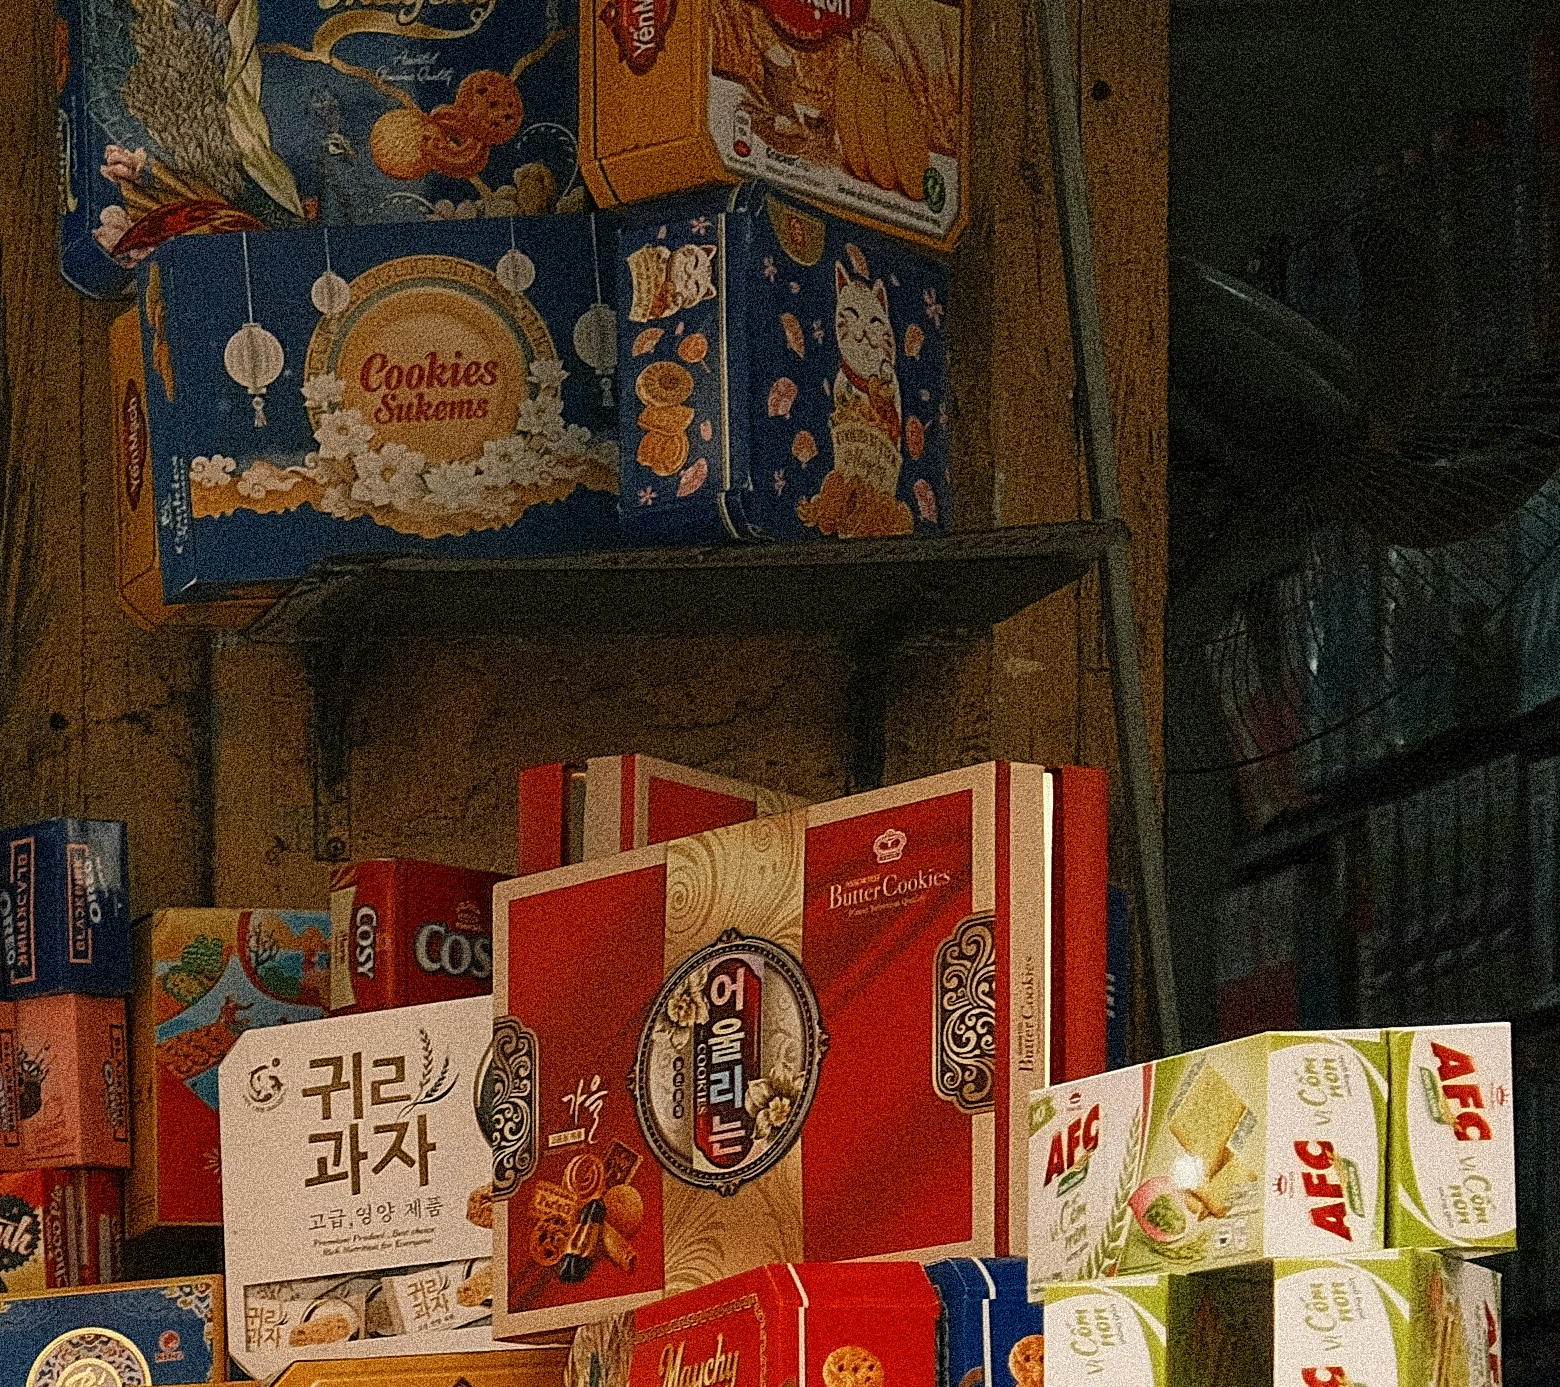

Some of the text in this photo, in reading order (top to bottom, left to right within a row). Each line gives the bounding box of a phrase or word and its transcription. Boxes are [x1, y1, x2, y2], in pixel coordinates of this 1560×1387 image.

[359, 349, 499, 395] Cookies
[373, 391, 490, 425] Sukems
[828, 866, 951, 909] Butter Cookies
[354, 904, 378, 980] COSY
[303, 1054, 411, 1126] 귀리
[1431, 1040, 1493, 1143] AFC
[305, 1116, 438, 1195] 과자
[1043, 1103, 1101, 1188] AFC
[1293, 1139, 1353, 1243] AFC
